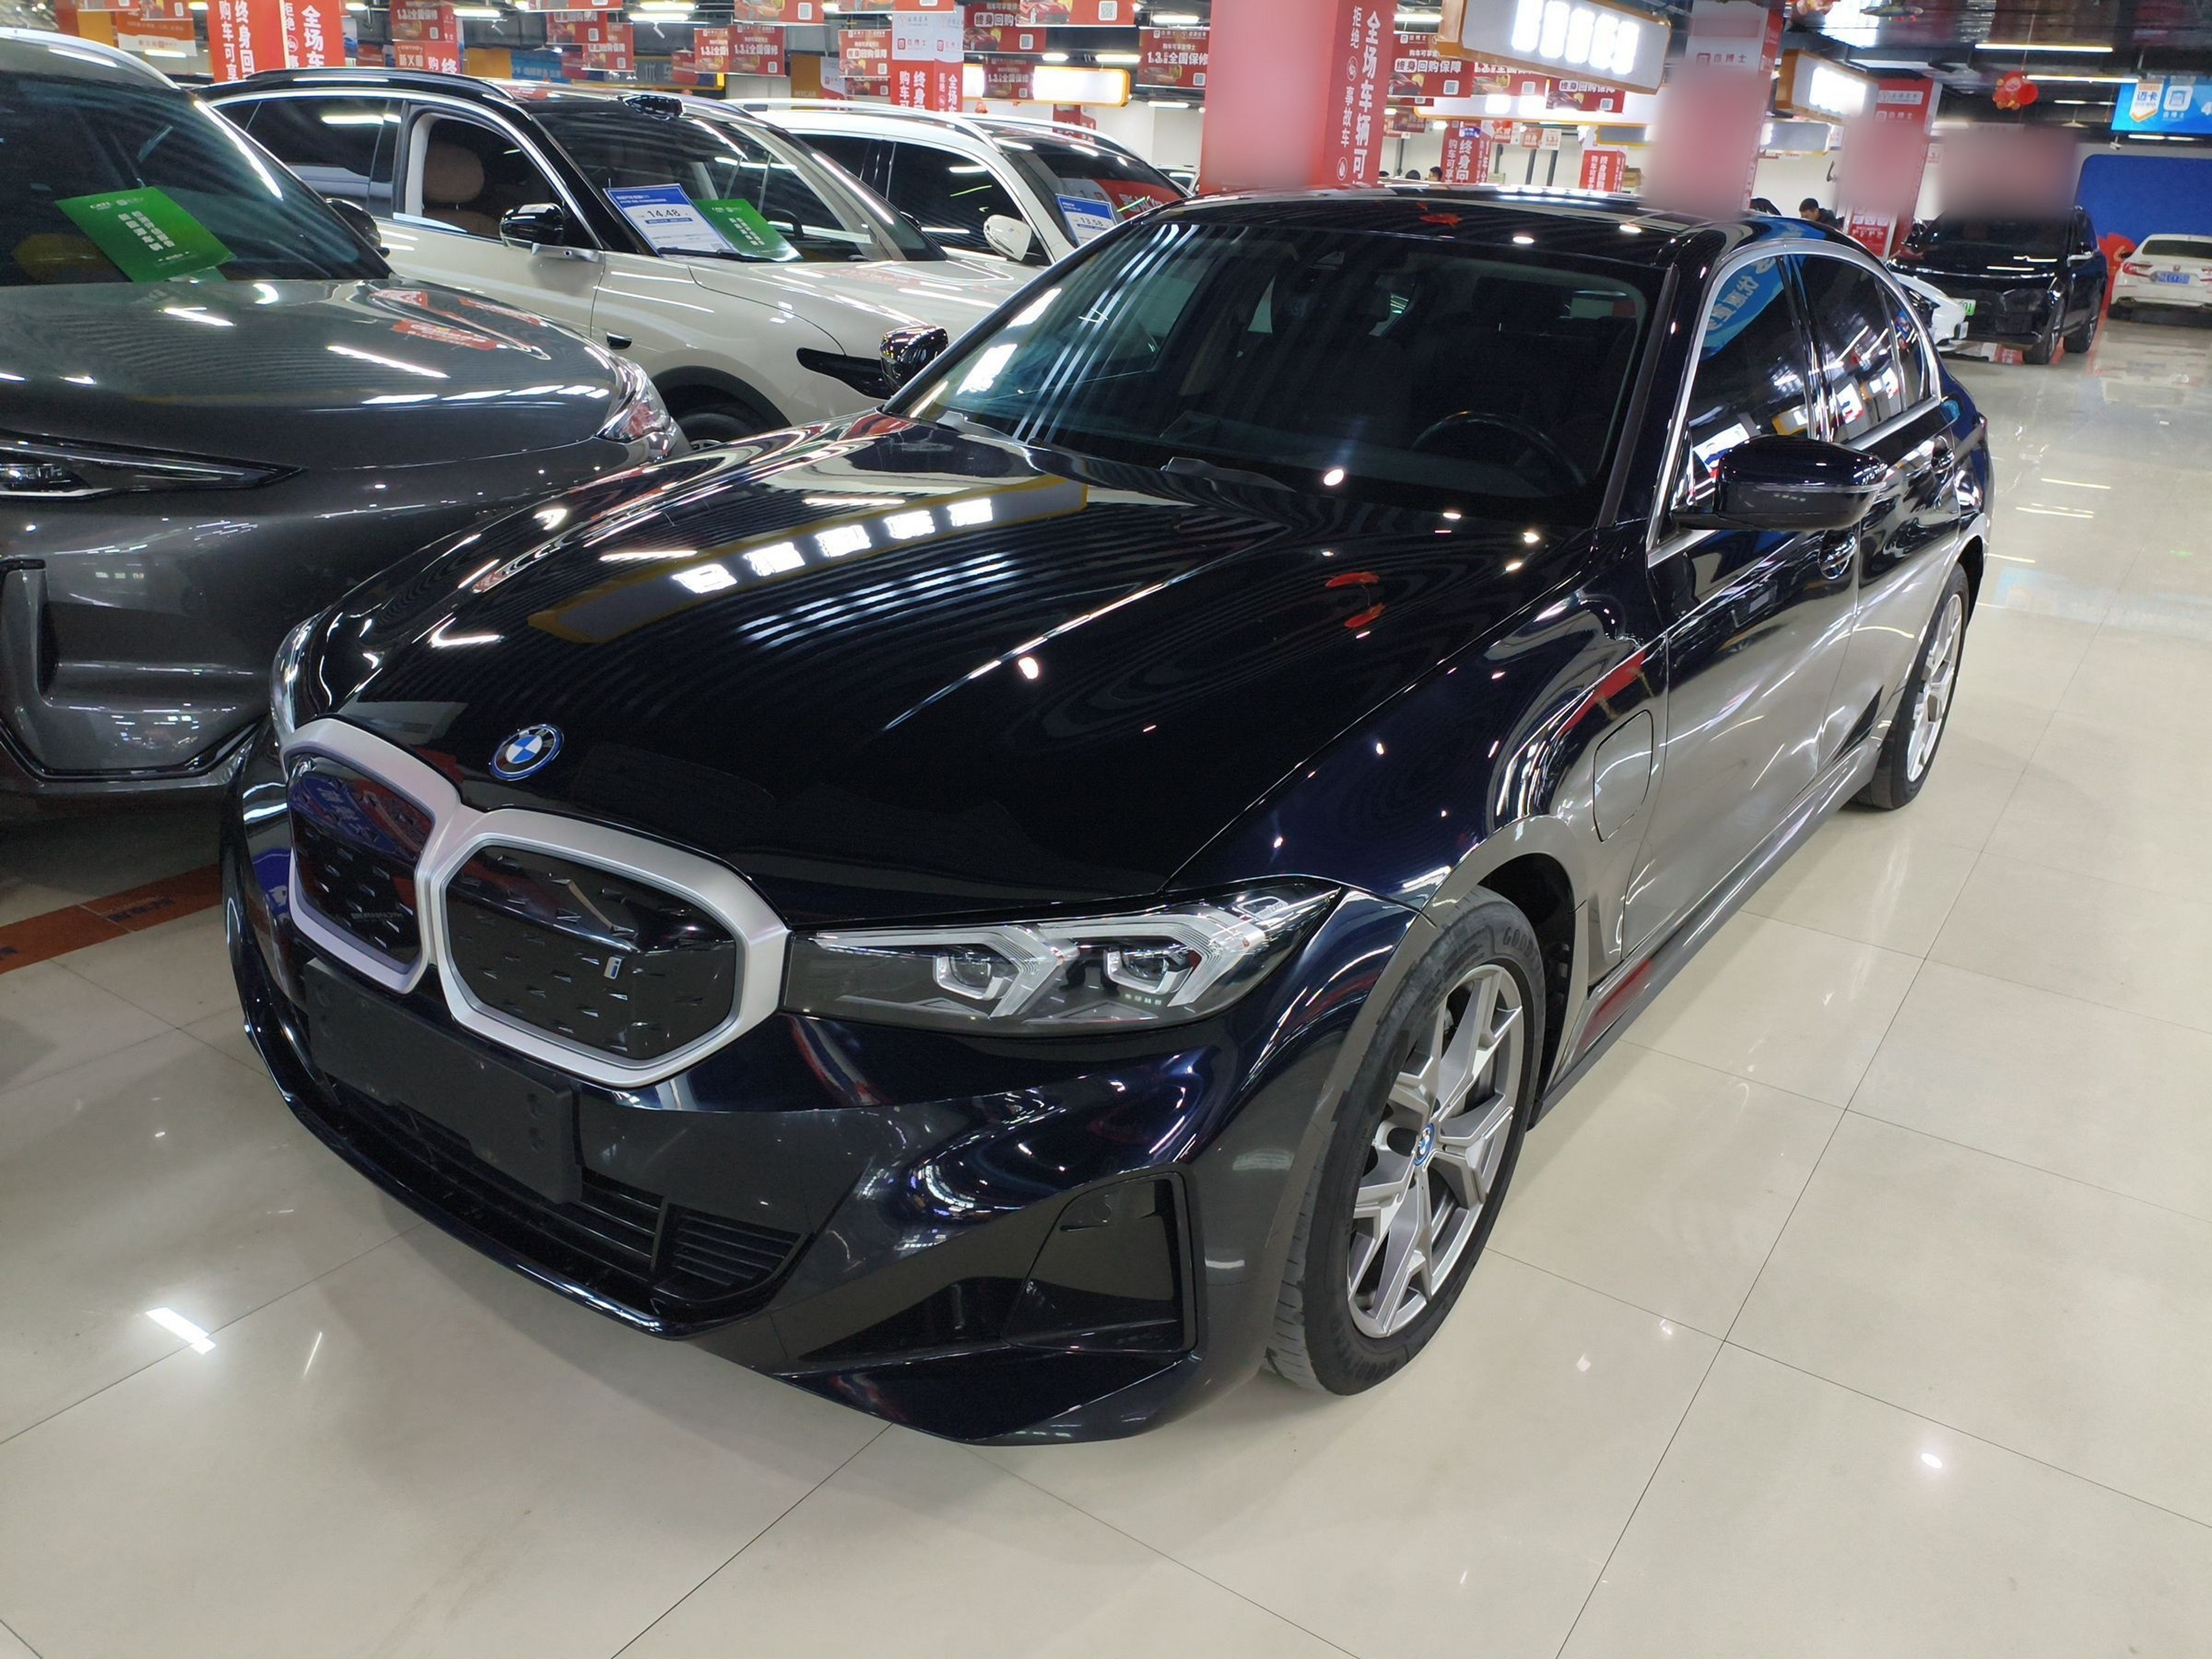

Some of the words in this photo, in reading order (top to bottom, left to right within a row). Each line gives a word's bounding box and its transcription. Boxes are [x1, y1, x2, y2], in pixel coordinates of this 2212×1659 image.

[235, 0, 255, 79] 终身回
[1350, 6, 1362, 49] 拒绝
[1395, 58, 1461, 73] 终身回购保障
[1340, 86, 1354, 148] 事故车
[1353, 10, 1381, 185] 全场车辆可
[1456, 139, 1472, 183] 终身回
[647, 209, 681, 218] 14.48
